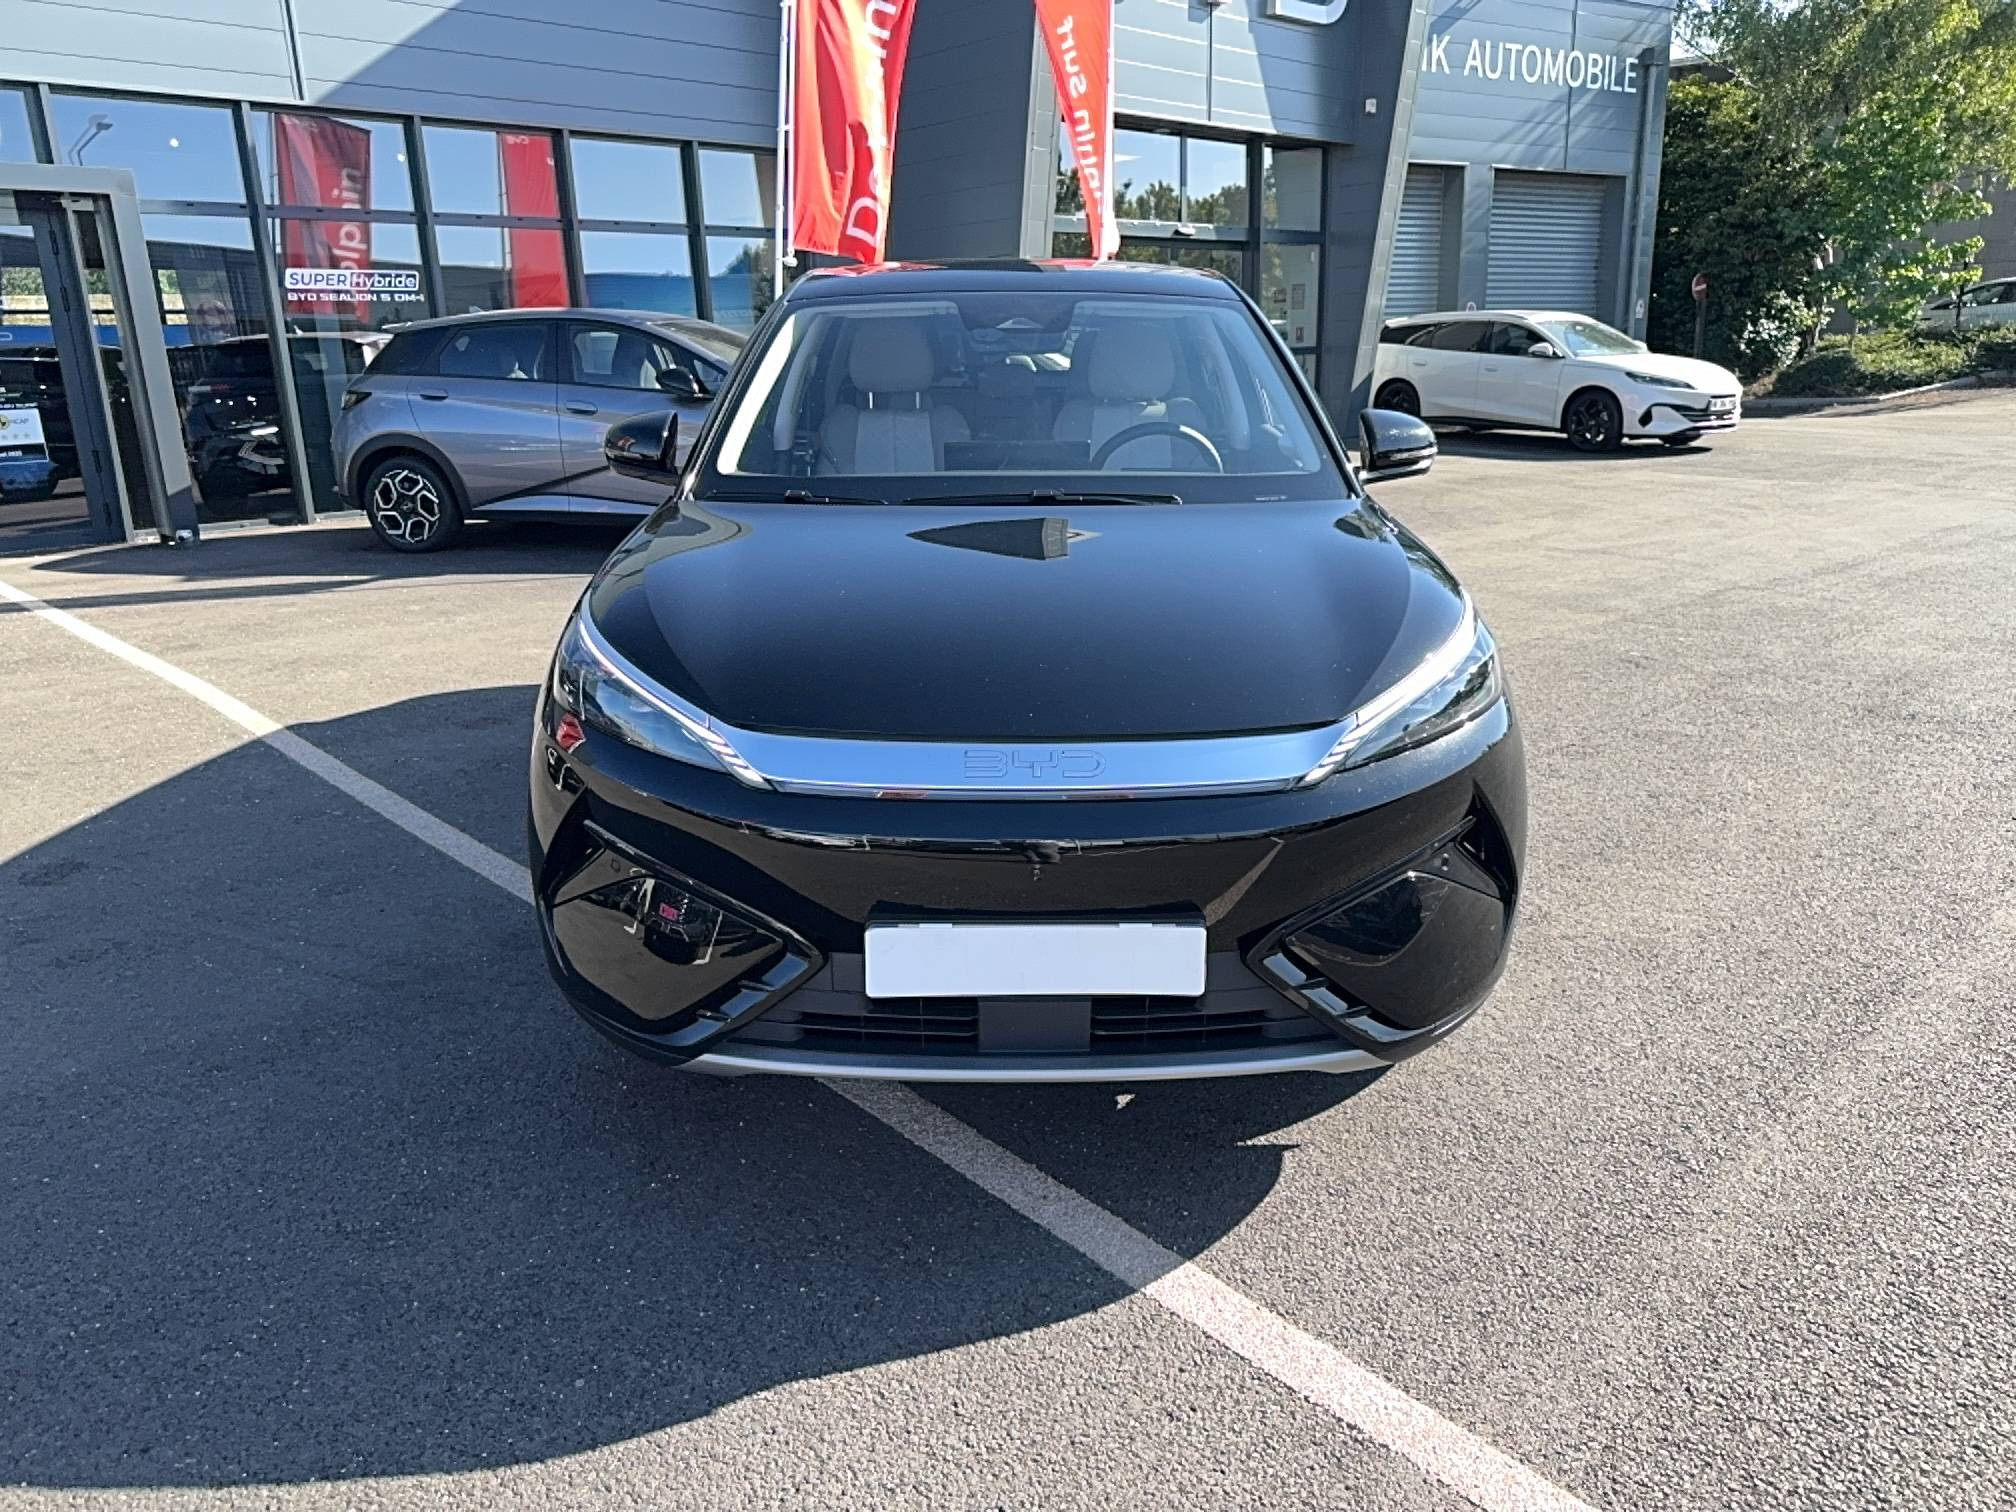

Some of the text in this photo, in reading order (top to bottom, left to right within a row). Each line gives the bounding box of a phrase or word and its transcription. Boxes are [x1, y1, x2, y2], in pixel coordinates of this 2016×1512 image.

[1463, 38, 1639, 94] AUTOMOBILE
[289, 272, 417, 290] SUPER Hybride
[287, 292, 317, 301] BYD
[319, 292, 378, 302] SEALION
[963, 749, 1107, 779] BYD
